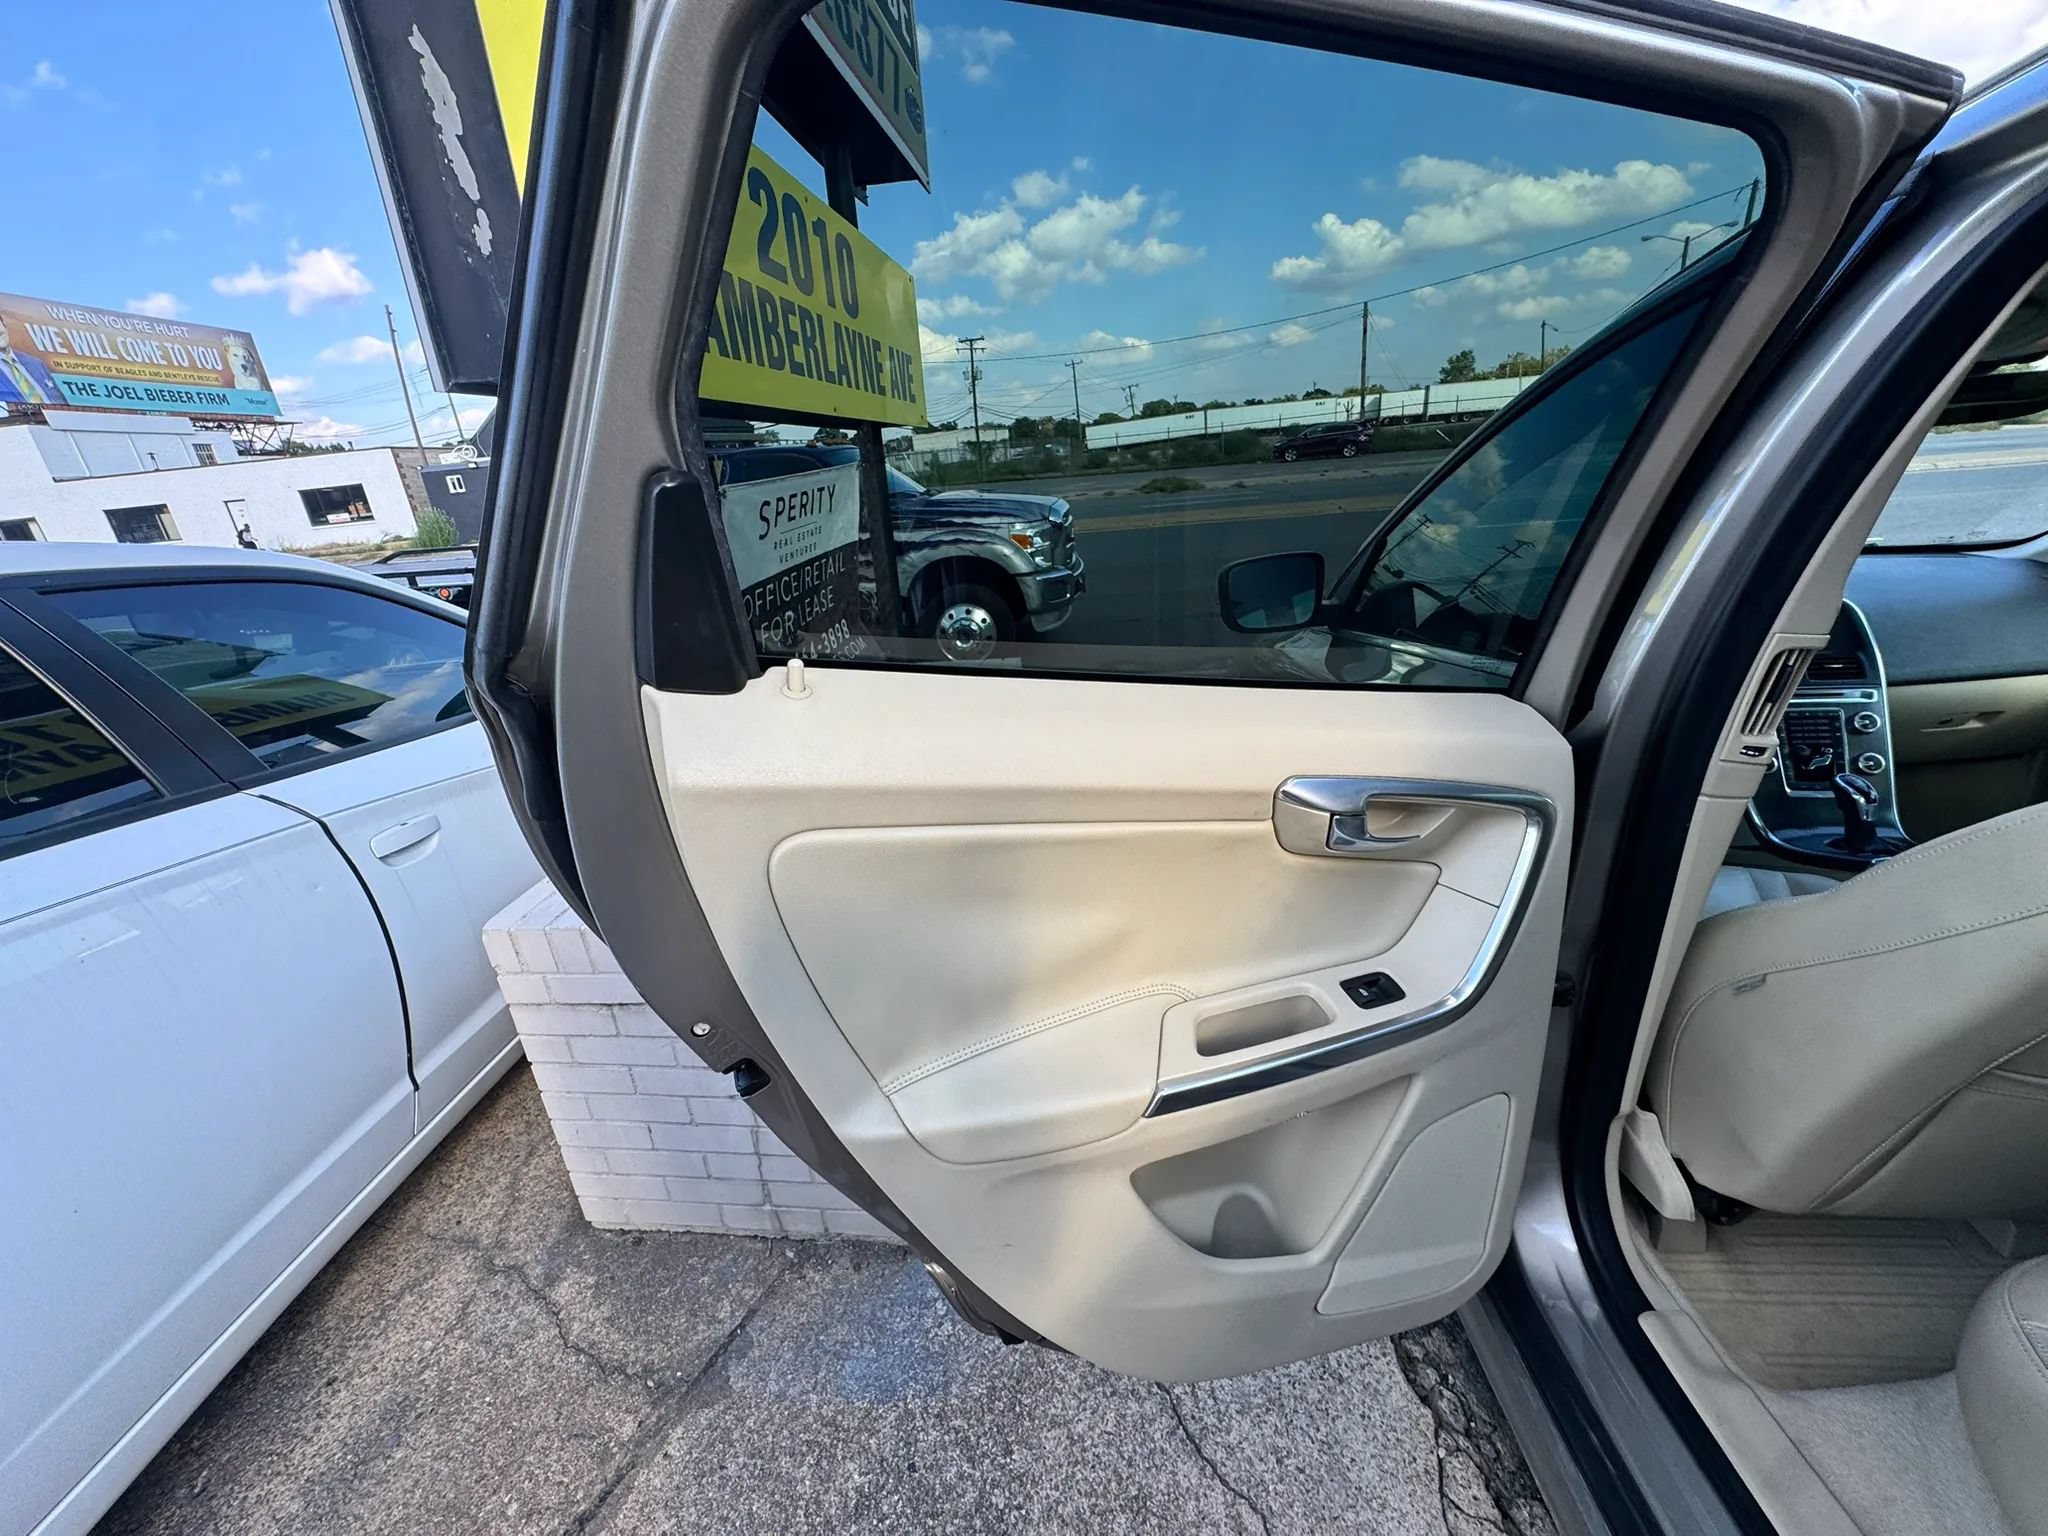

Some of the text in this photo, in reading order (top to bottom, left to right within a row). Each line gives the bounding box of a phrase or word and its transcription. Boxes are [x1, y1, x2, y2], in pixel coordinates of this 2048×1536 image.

[747, 166, 860, 320] 2010
[45, 304, 189, 339] WHEN YOU'RE HURT
[24, 323, 223, 371] WE WILL COME TO YOU
[53, 361, 64, 369] IN
[64, 361, 101, 372] SUPPORT
[103, 365, 114, 374] OF
[114, 366, 148, 378] BEAGLES
[148, 369, 163, 379] AND
[196, 374, 221, 384] RESCUE
[62, 380, 101, 398] THE
[103, 384, 144, 402] JOEL
[144, 387, 197, 405] BIEBER
[195, 391, 231, 406] FIRM
[888, 345, 917, 404] AVE
[758, 483, 836, 541] SPERITY
[773, 525, 823, 551] REAL ESTATE
[778, 542, 818, 565] VENTURES
[743, 551, 846, 622] OFFICE/RETAIL
[760, 585, 835, 653] FOR LEASE
